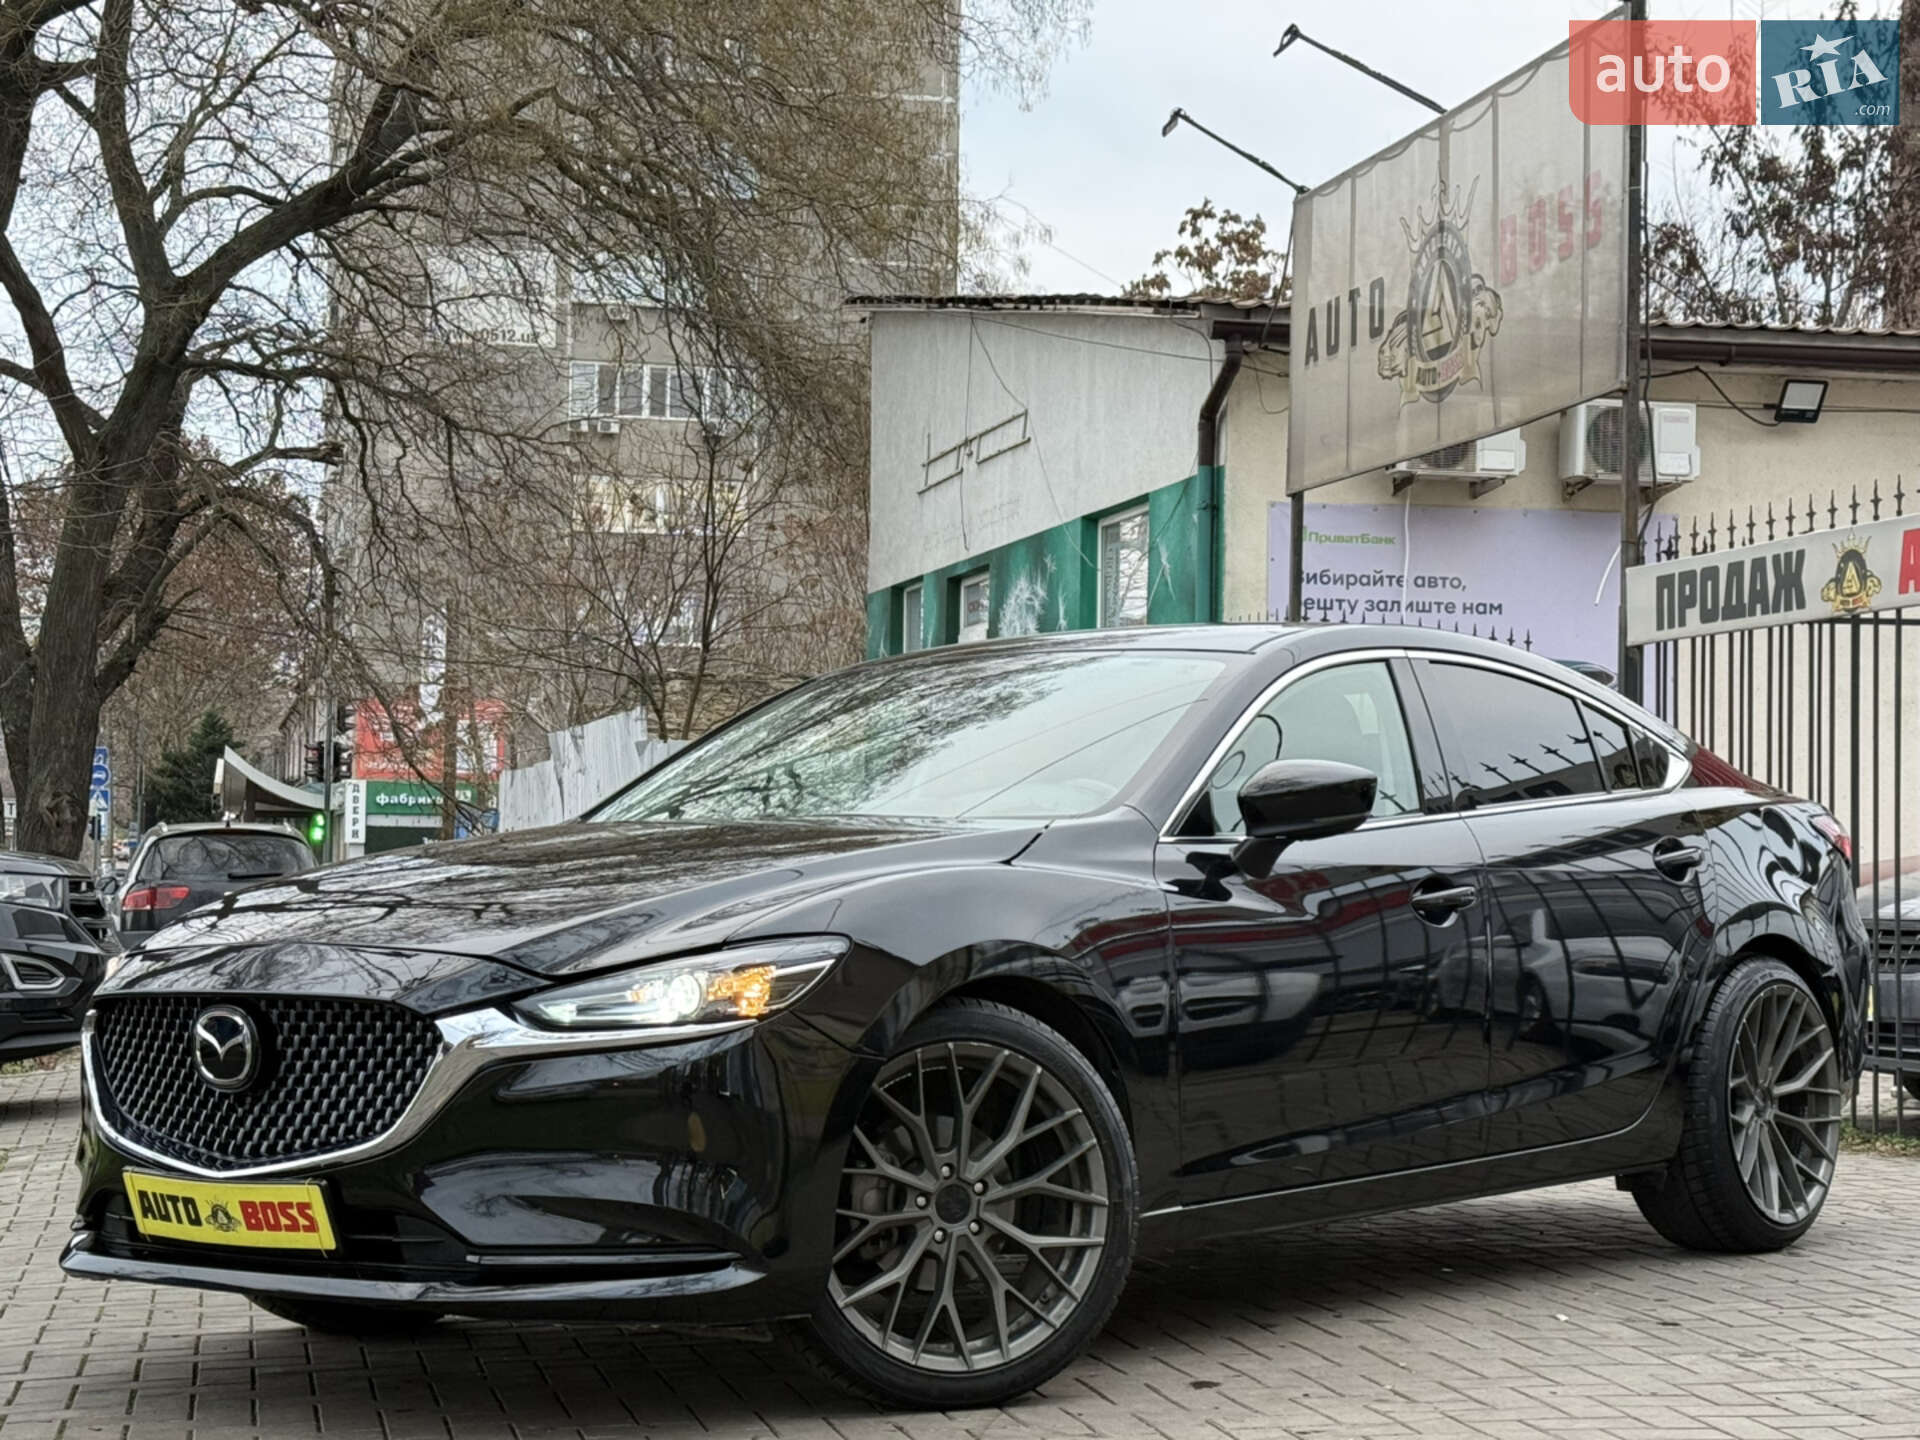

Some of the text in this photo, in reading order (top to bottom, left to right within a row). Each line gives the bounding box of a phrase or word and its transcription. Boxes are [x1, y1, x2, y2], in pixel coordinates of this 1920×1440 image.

[1304, 169, 1603, 367] AUTO BOSS
[1309, 530, 1397, 545] ПриватБанк
[1302, 568, 1468, 592] ибирайте авто,
[1656, 548, 1806, 631] ПРОДАЖ
[1302, 597, 1359, 615] ешту
[1462, 602, 1503, 615] нам
[137, 1190, 320, 1233] AUTO BOSS
